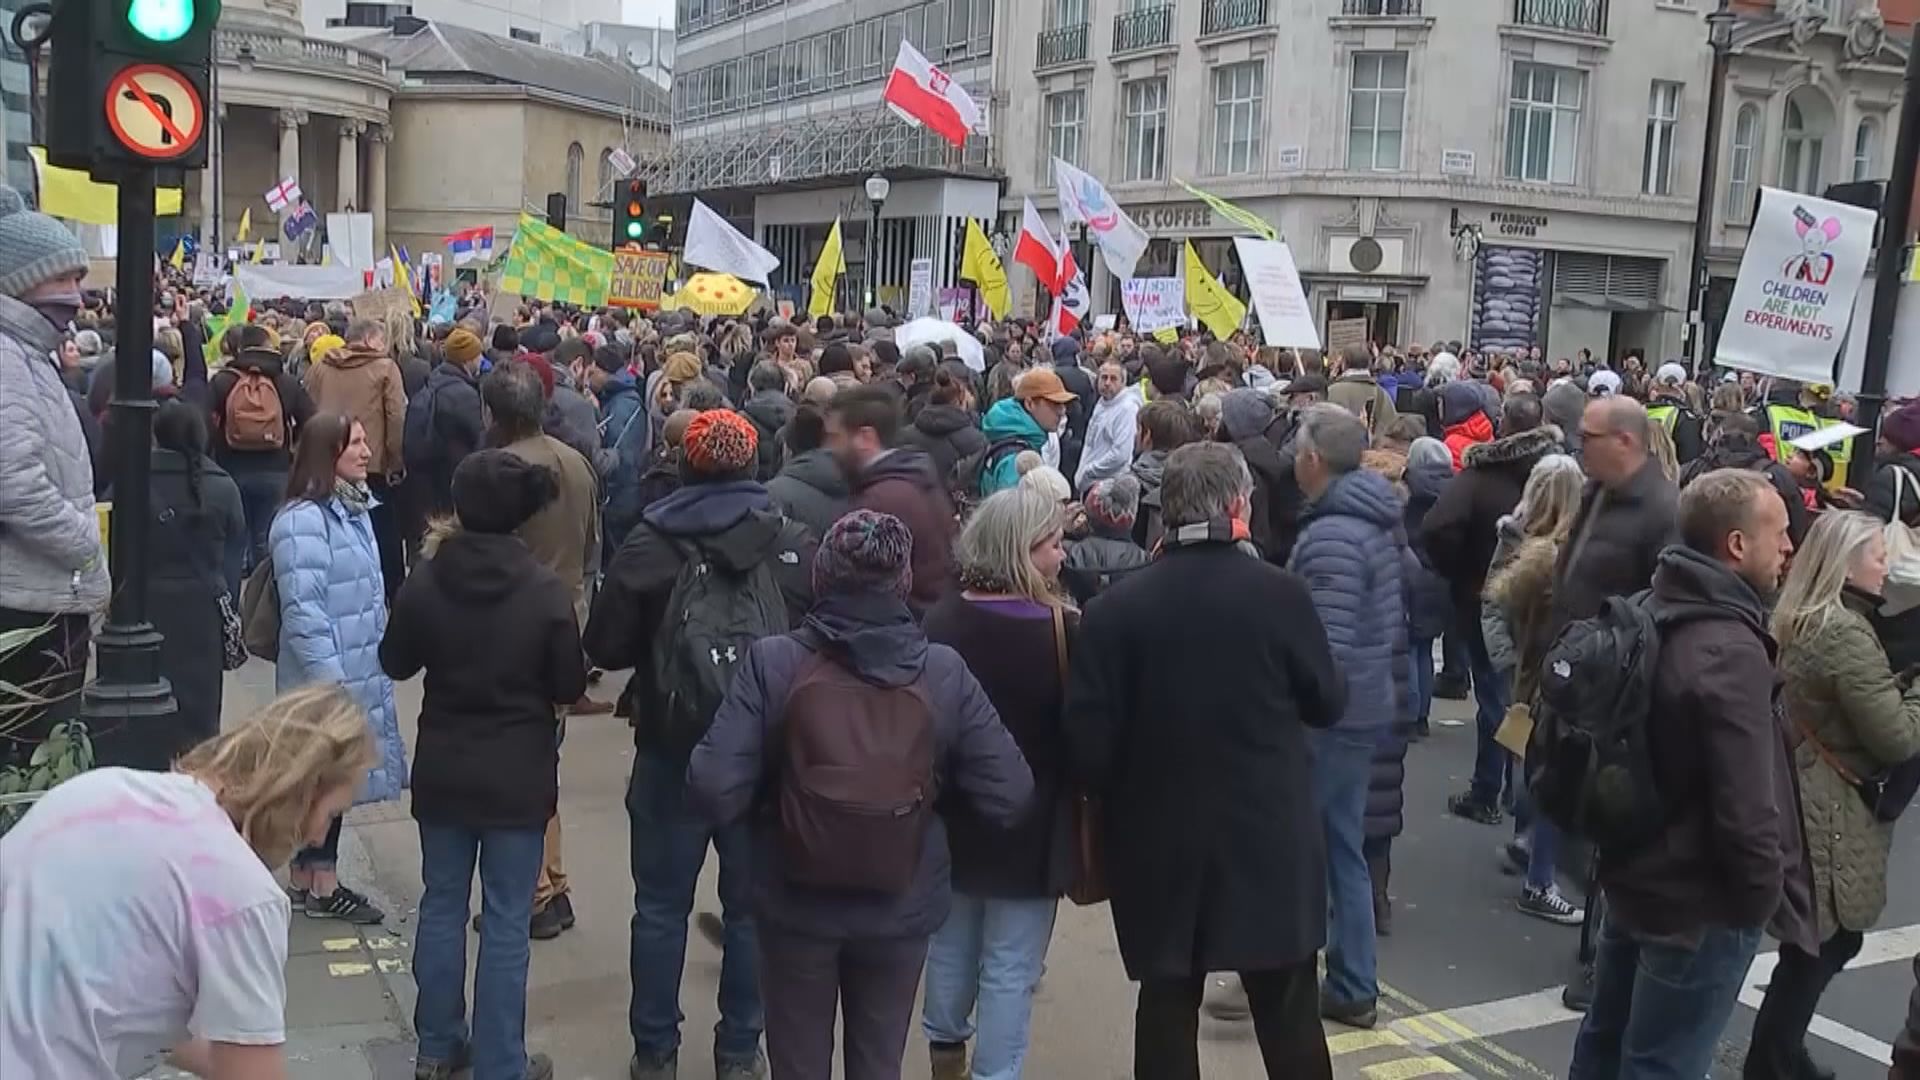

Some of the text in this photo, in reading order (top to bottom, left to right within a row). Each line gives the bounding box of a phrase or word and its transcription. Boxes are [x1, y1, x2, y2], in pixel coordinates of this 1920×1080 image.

[1153, 206, 1212, 229] COFFEE
[1490, 212, 1548, 228] STARBUCKS
[1500, 224, 1537, 237] COFFEE
[615, 255, 646, 276] SAVE
[611, 278, 661, 299] CHILDREN
[1762, 280, 1829, 306] CHILDREN
[1762, 297, 1821, 321] ARE NOT
[1744, 309, 1833, 340] EXPERIMENTS
